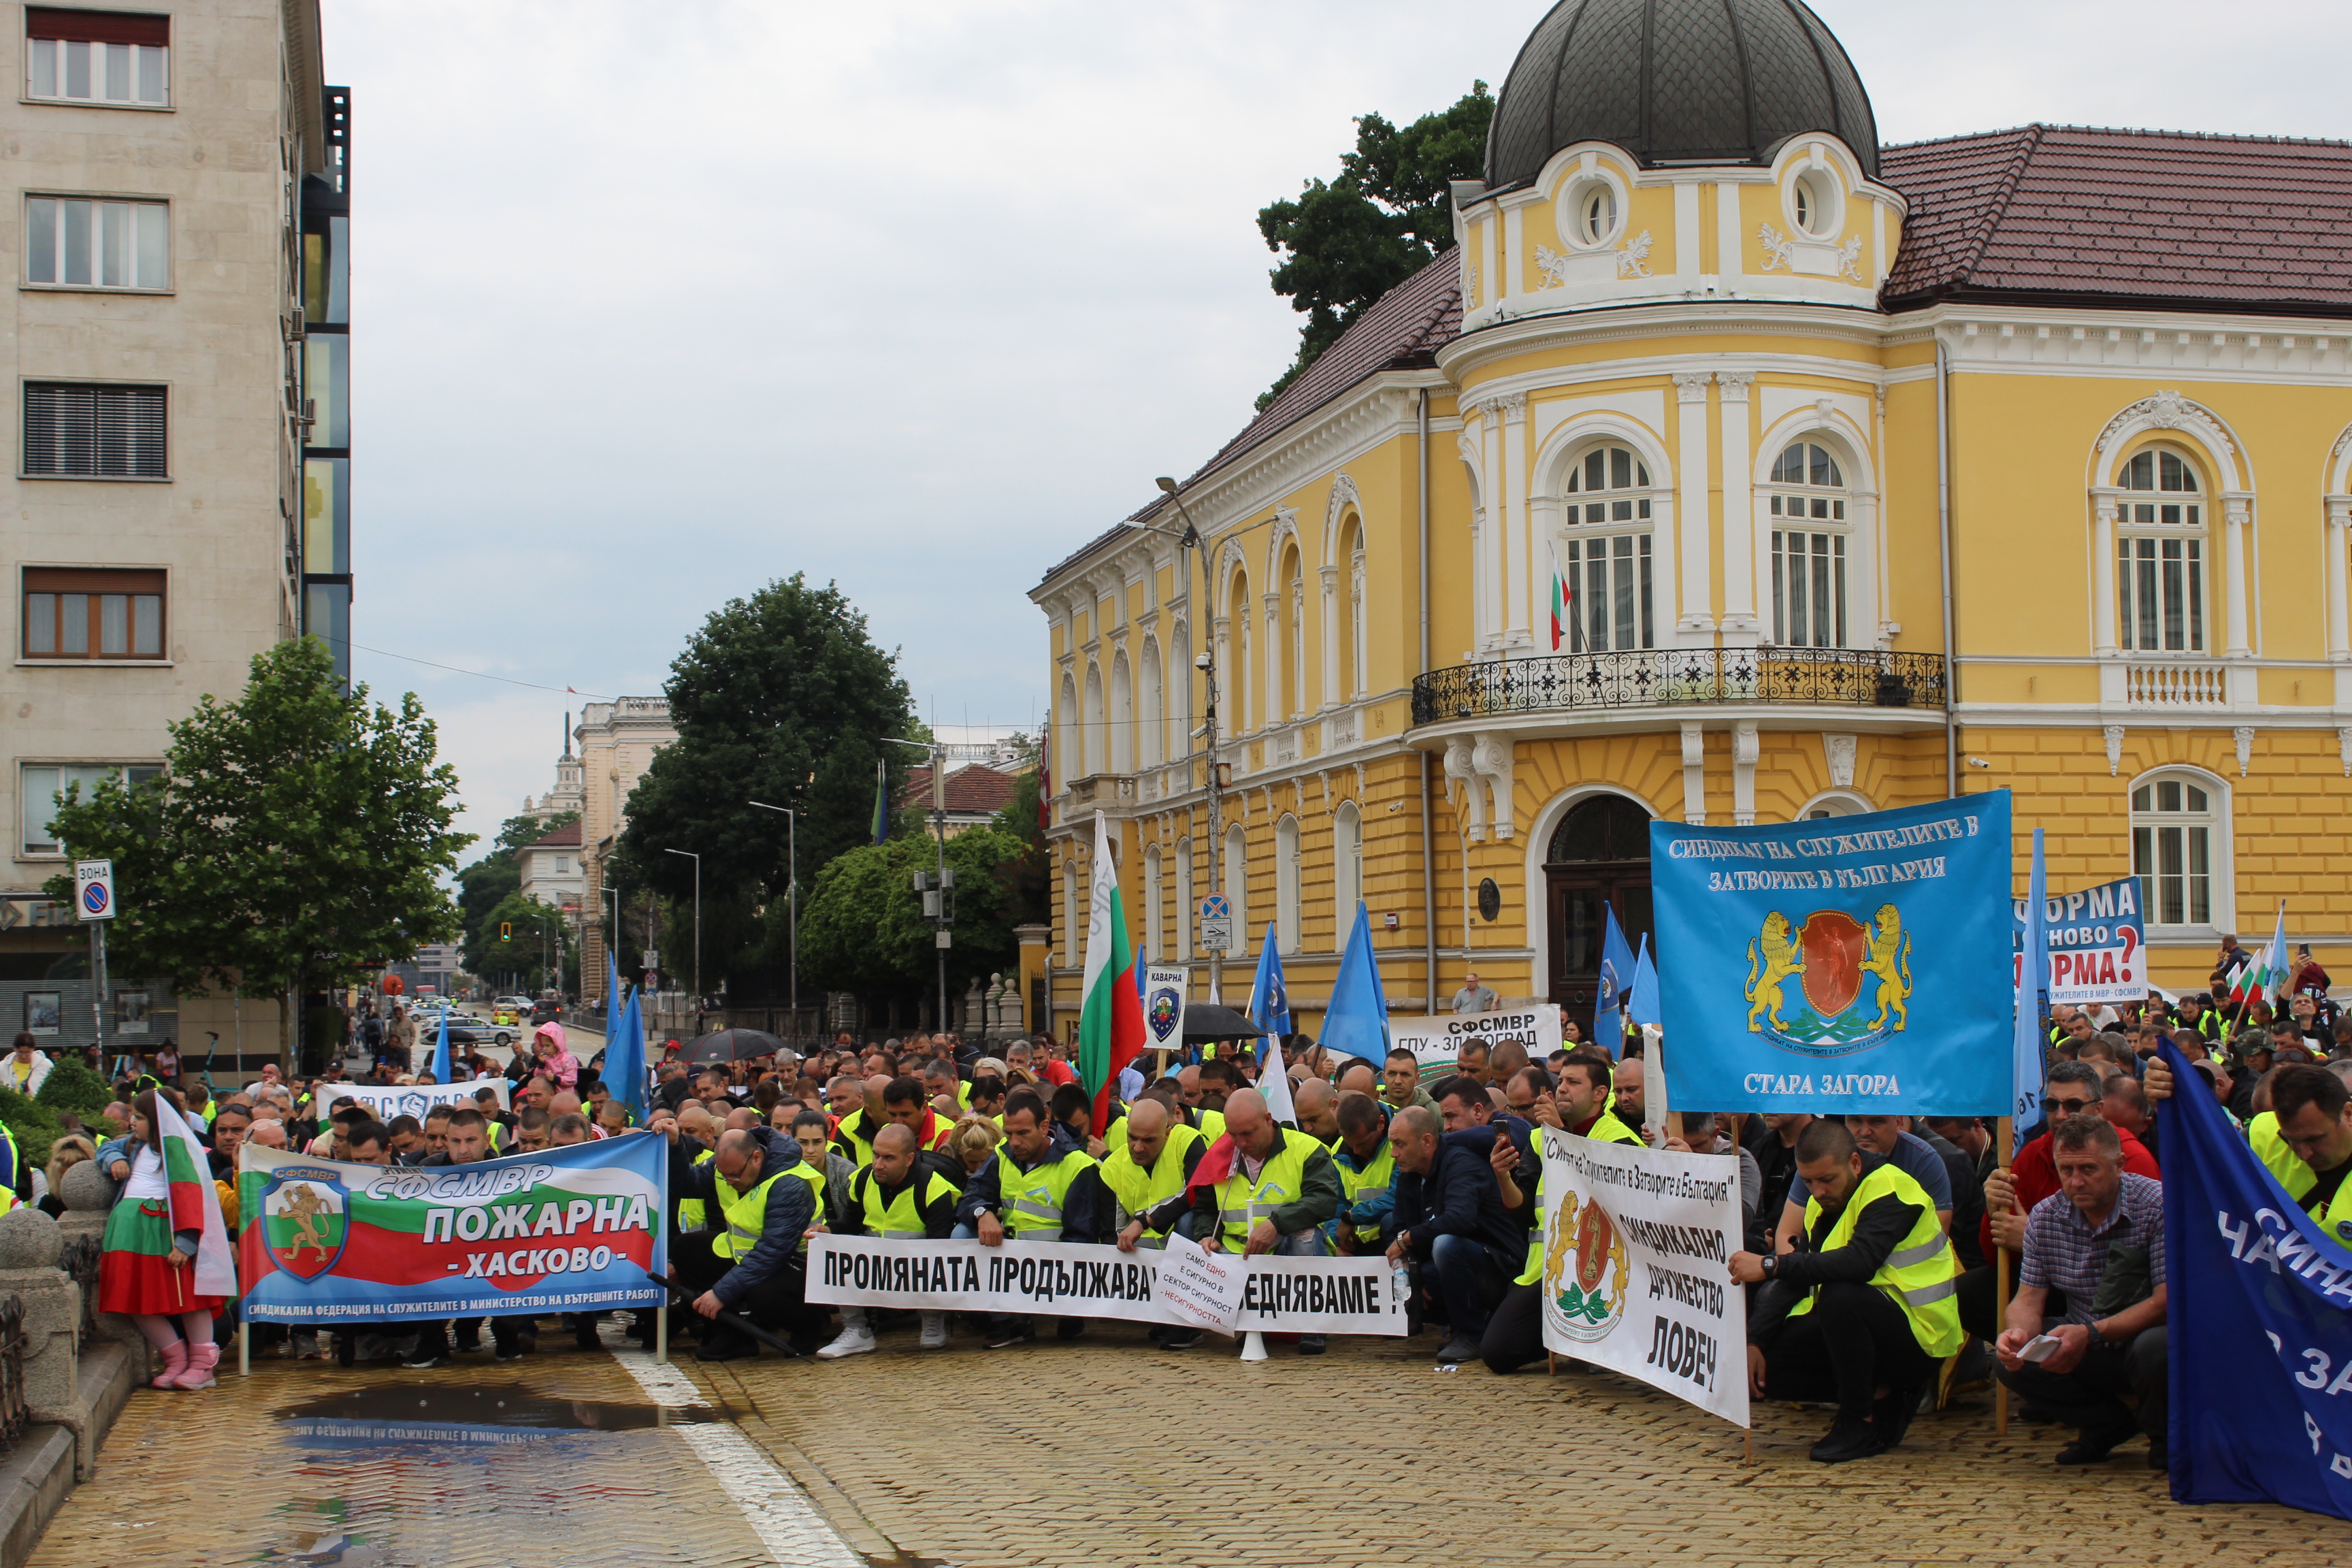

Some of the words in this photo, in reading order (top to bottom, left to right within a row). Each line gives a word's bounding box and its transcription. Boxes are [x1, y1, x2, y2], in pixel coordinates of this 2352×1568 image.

[1668, 838, 1763, 862] СИНДИКАТ
[1769, 840, 1796, 860] НА
[1797, 818, 1963, 858] СЛУЖИТЕЛИТЕ
[1966, 815, 1980, 837] В
[79, 866, 108, 880] ЗОНА
[1708, 870, 1819, 892] ЗАТВОРИТЕ
[1822, 870, 1835, 889] В
[1837, 856, 1946, 889] БЪЛГАРИЯ
[1151, 973, 1182, 983] КАВАРНА
[2089, 990, 2094, 998] В
[2095, 989, 2110, 998] МВР
[2114, 987, 2142, 997] СФСМВР
[1399, 1037, 1429, 1051] ГПУ
[1443, 1030, 1537, 1051] ЗЛОГРАД
[1448, 1014, 1535, 1034] СФСМВР
[1761, 1030, 1785, 1046] СИНДИКАТ
[1793, 1045, 1828, 1055] СЛУЖИТЕЛИТЕ
[1833, 1044, 1861, 1054] ЗАТВОРИТЕ
[1867, 1030, 1892, 1045] БЪЛГАРИЯ
[1744, 1073, 1814, 1095] СТАРА
[1820, 1073, 1900, 1096] ЗАГОРА
[275, 1169, 337, 1181] СФСМВР
[365, 1164, 553, 1201] СФСМВР
[1628, 1170, 1633, 1188] в
[1634, 1164, 1675, 1200] Затворите
[1675, 1178, 1680, 1196] в
[423, 1194, 651, 1243] ПОЖАРНА
[1619, 1213, 1726, 1264] СИНДИКАЛНО
[463, 1245, 612, 1278] ХАСКОВО
[824, 1250, 981, 1293] ПРОМЯНАТА
[1180, 1265, 1186, 1273] Е
[1186, 1269, 1217, 1290] СИГУРНО
[1186, 1252, 1205, 1267] САМО
[1206, 1263, 1226, 1278] ЕДНО
[248, 1303, 314, 1317] СИНДИКАЛНА
[315, 1304, 371, 1317] ФЕДЕРАЦИЯ
[373, 1303, 386, 1314] НА
[387, 1301, 458, 1314] СЛУЖИТЕЛИТЕ
[461, 1300, 468, 1310] В
[470, 1295, 546, 1310] МИНИСТЕРСТВО
[549, 1294, 562, 1305] НА
[565, 1290, 624, 1304] ВЪТРЕШНИТЕ
[1163, 1274, 1190, 1292] СЕКТОР
[1191, 1288, 1232, 1313] СИГУРНОСТ
[1239, 1273, 1380, 1319] ЕДНЯВАМЕ
[1646, 1262, 1724, 1320] ДРУЖЕСТВО
[1164, 1290, 1228, 1328] НЕСИГУРНОСТТА...
[1647, 1315, 1717, 1392] ЛОВЕЧ
